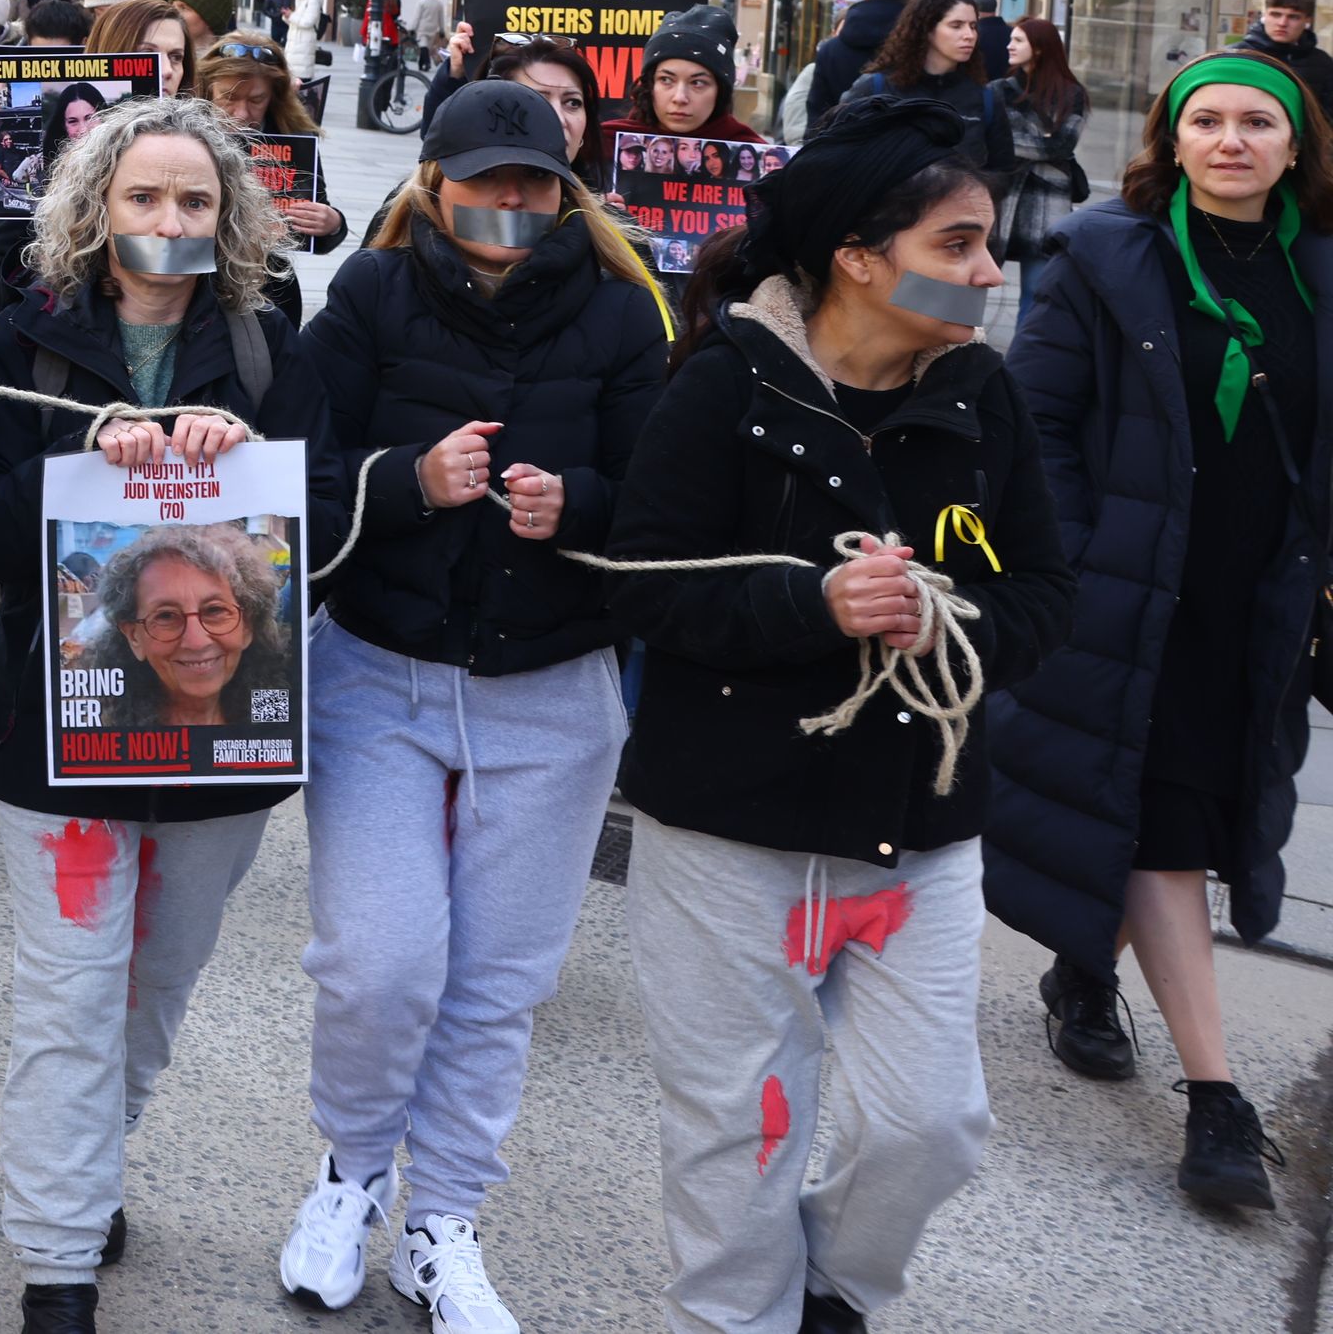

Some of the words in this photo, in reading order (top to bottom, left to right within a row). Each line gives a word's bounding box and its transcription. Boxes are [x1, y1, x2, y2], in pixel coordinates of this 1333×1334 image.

[506, 6, 593, 34] SISTERS
[599, 9, 664, 36] HOME
[22, 59, 60, 79] BACK
[64, 59, 109, 78] HOME
[113, 58, 153, 77] NOW!
[662, 181, 687, 201] WE
[692, 183, 723, 204] ARE
[629, 206, 664, 231] FOR
[671, 209, 710, 234] YOU
[123, 482, 150, 500] JUDI
[153, 481, 220, 500] WEINSTEIN
[159, 502, 185, 521] (70)
[60, 667, 125, 698] BRING
[61, 699, 103, 728] HER
[62, 732, 121, 762] HOME
[128, 727, 190, 761] NOW!
[213, 740, 247, 751] HOSTAGES
[247, 740, 262, 750] AND
[262, 739, 292, 751] MISSING
[213, 750, 256, 764] FAMILIES
[257, 749, 293, 763] FORUM
